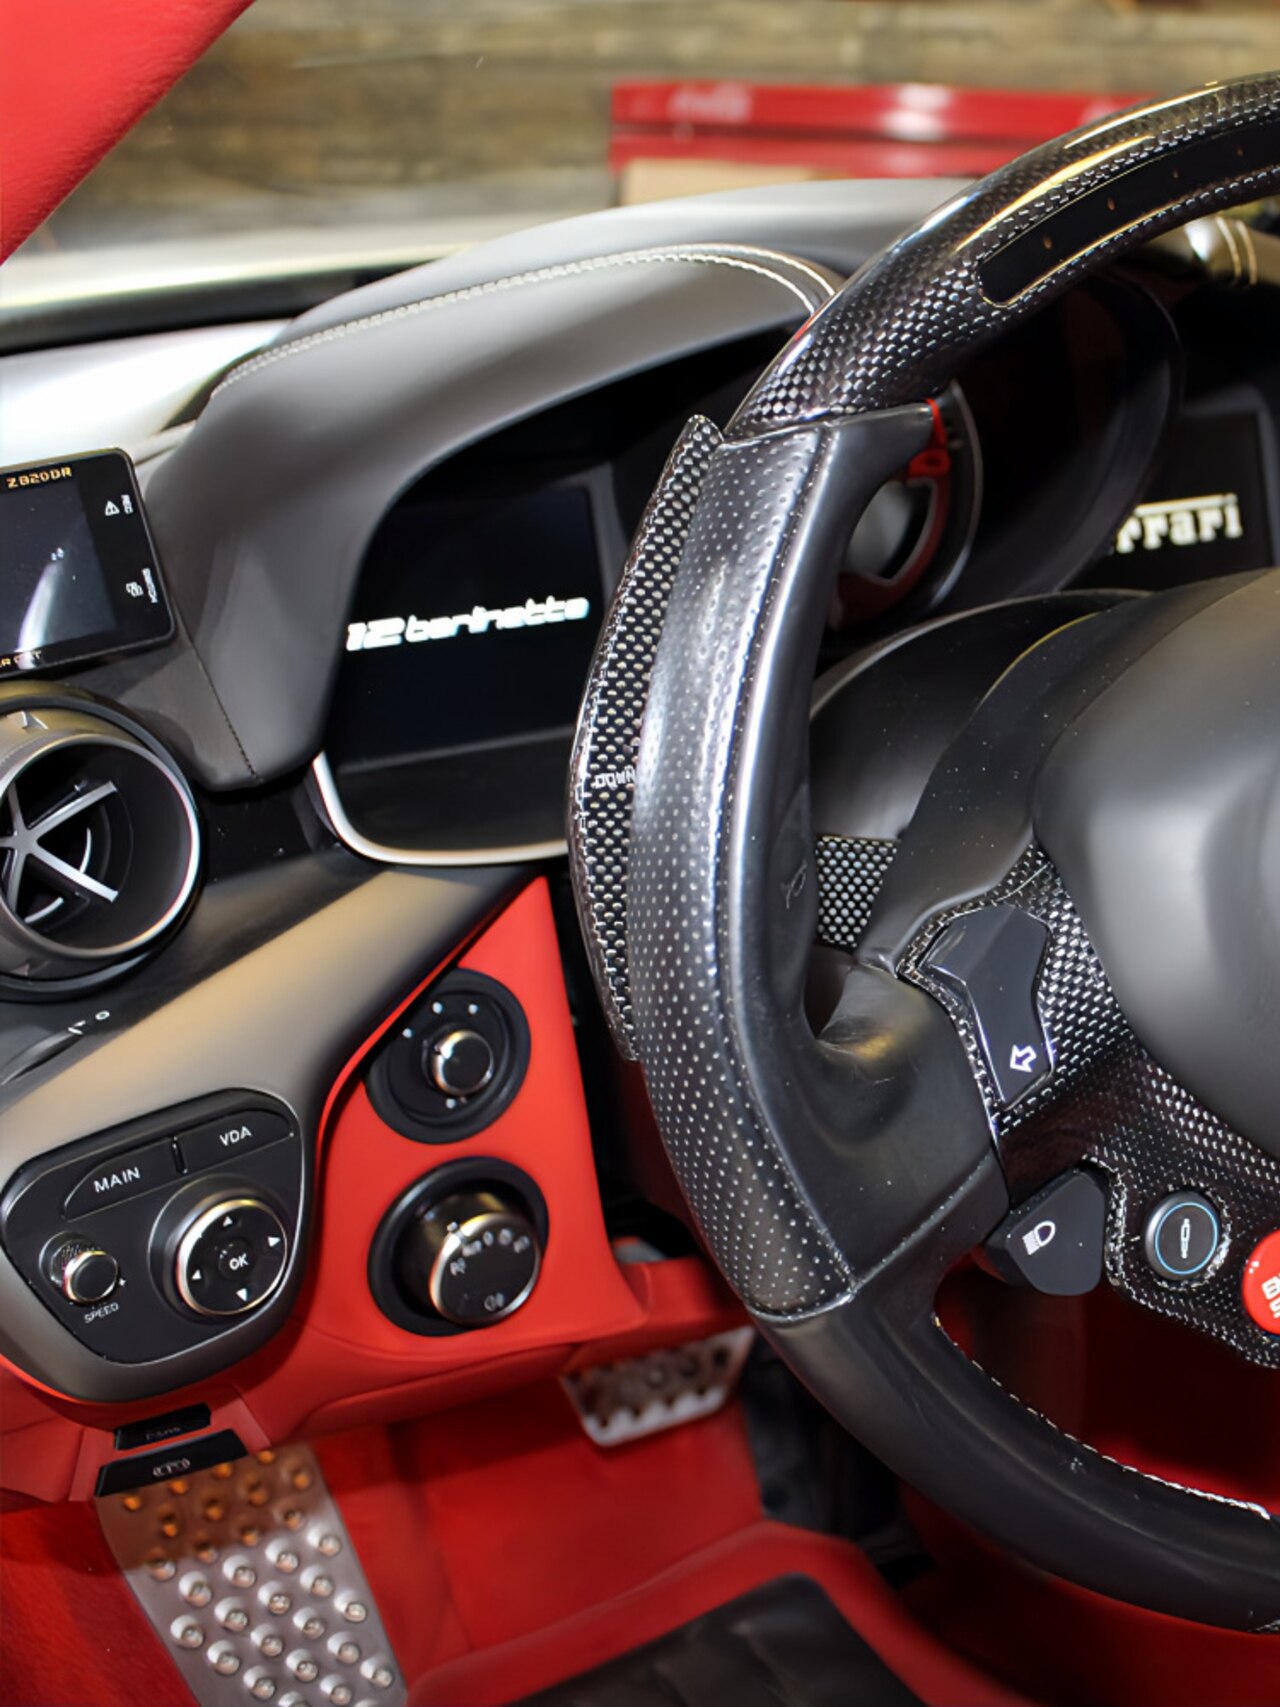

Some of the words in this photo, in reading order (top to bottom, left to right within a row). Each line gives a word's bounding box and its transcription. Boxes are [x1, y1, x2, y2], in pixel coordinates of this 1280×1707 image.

[1115, 492, 1243, 554] rrari
[346, 616, 406, 651] 12
[218, 1125, 253, 1147] VDA
[93, 1165, 142, 1193] MAIN
[228, 1252, 249, 1271] OK
[83, 1302, 120, 1324] SPEED
